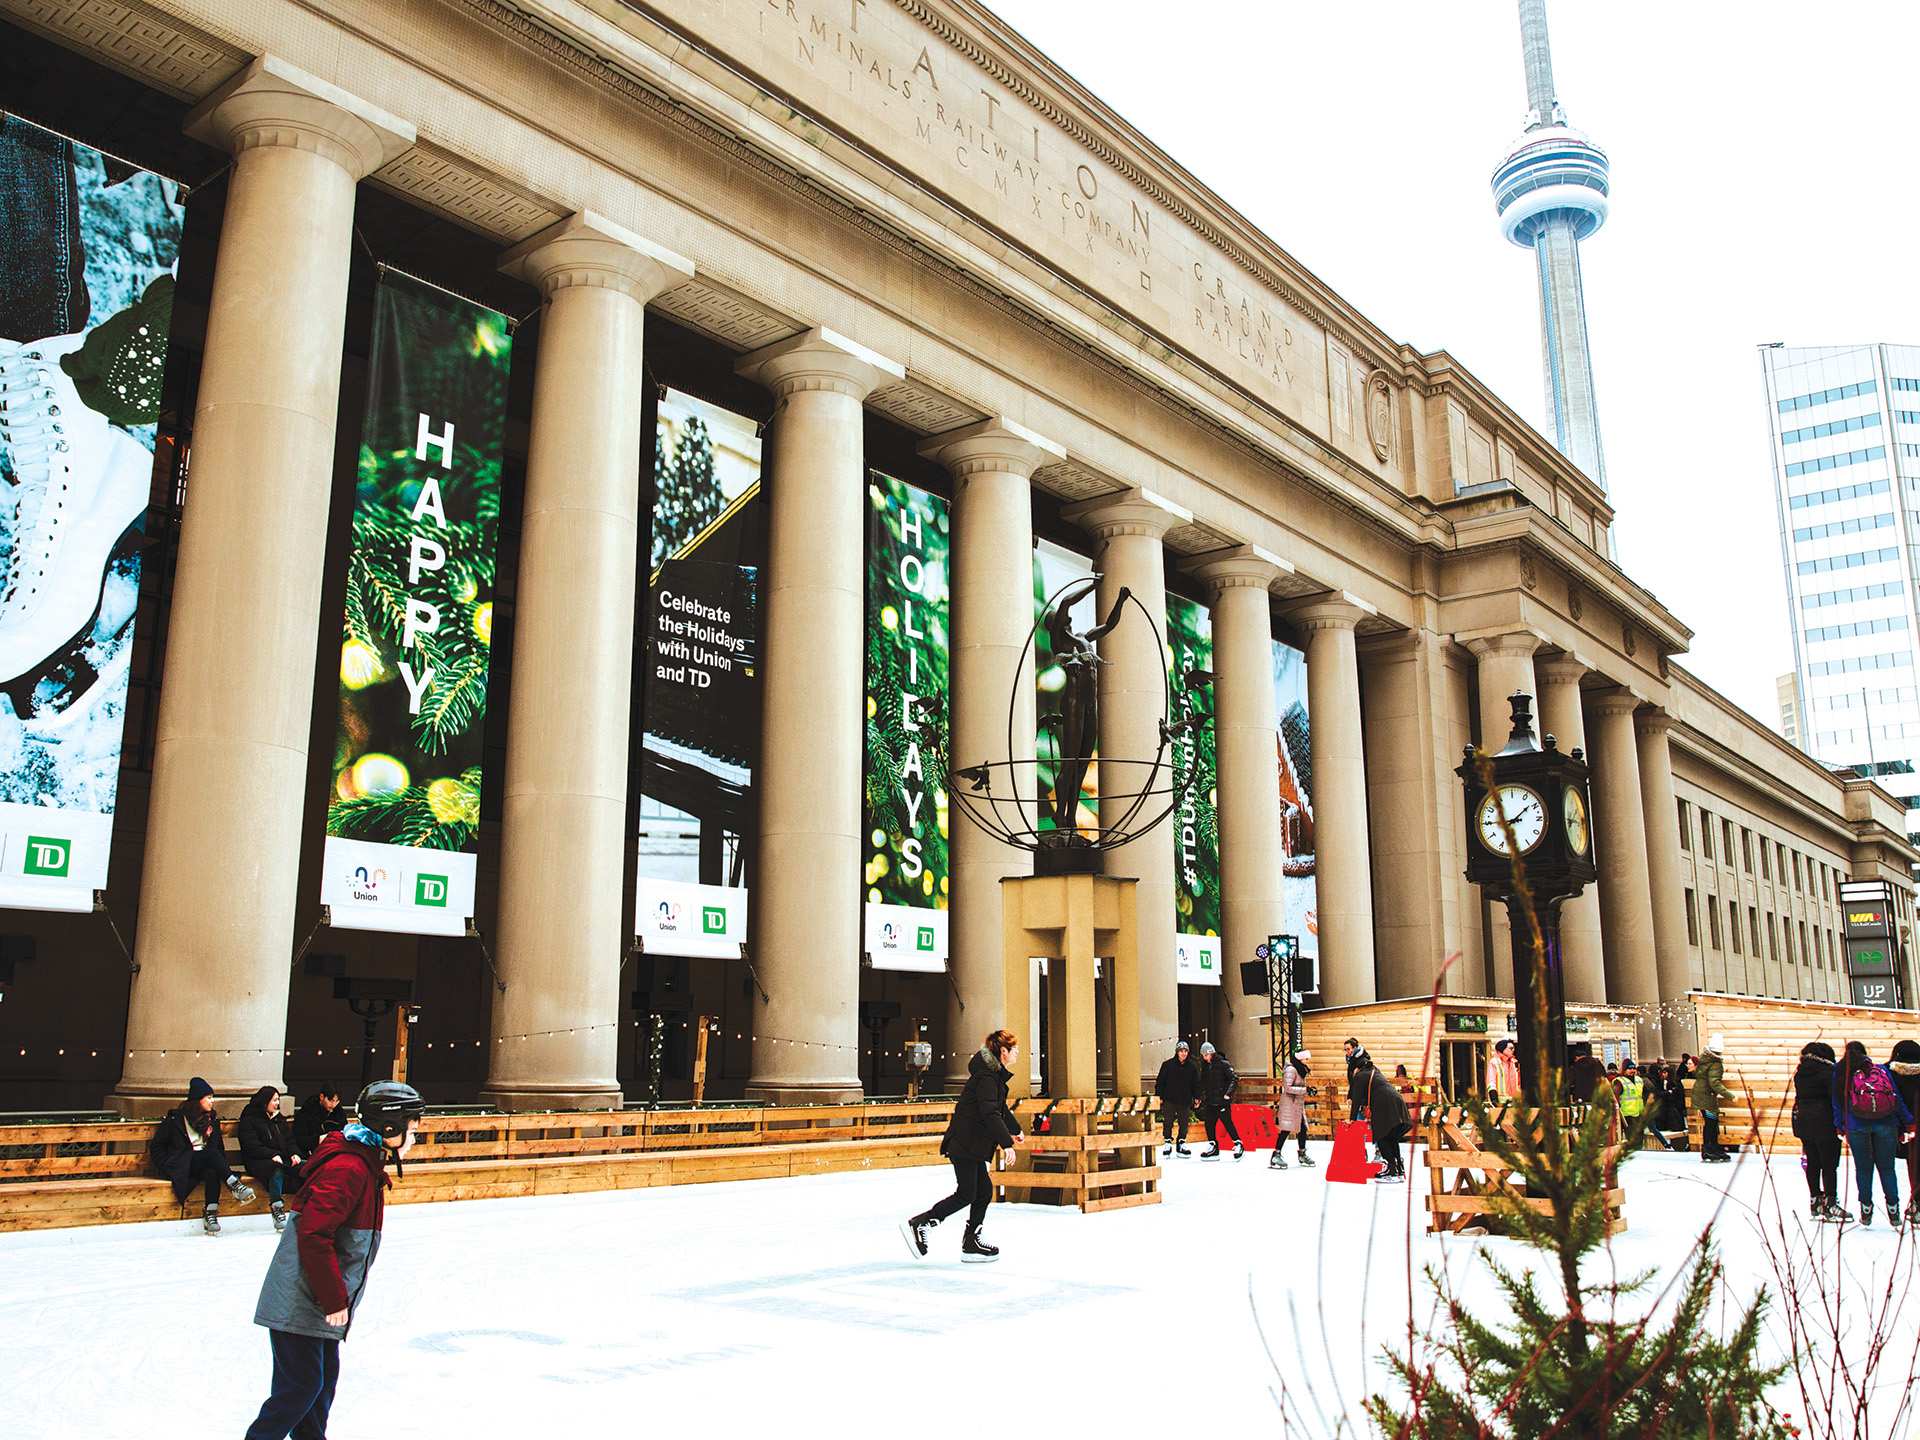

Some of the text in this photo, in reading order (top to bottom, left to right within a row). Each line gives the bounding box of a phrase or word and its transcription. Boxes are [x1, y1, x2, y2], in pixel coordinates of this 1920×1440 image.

[937, 102, 1040, 187] RAILWAY
[1062, 193, 1150, 264] COMPANY
[1194, 263, 1293, 346] GRAND
[1206, 293, 1284, 363] TRUNK
[1195, 308, 1294, 389] RAILWAY
[397, 412, 455, 715] HAPPY
[660, 591, 731, 624] Celebrate
[658, 614, 745, 652] the Holidays
[657, 640, 732, 671] with Union
[656, 665, 711, 688] and TD
[31, 843, 66, 869] TD
[353, 891, 378, 902] Union
[419, 879, 445, 901] TD
[659, 923, 677, 931] Union
[704, 911, 724, 929] TD
[919, 930, 933, 946] TD
[1863, 984, 1885, 998] UP
